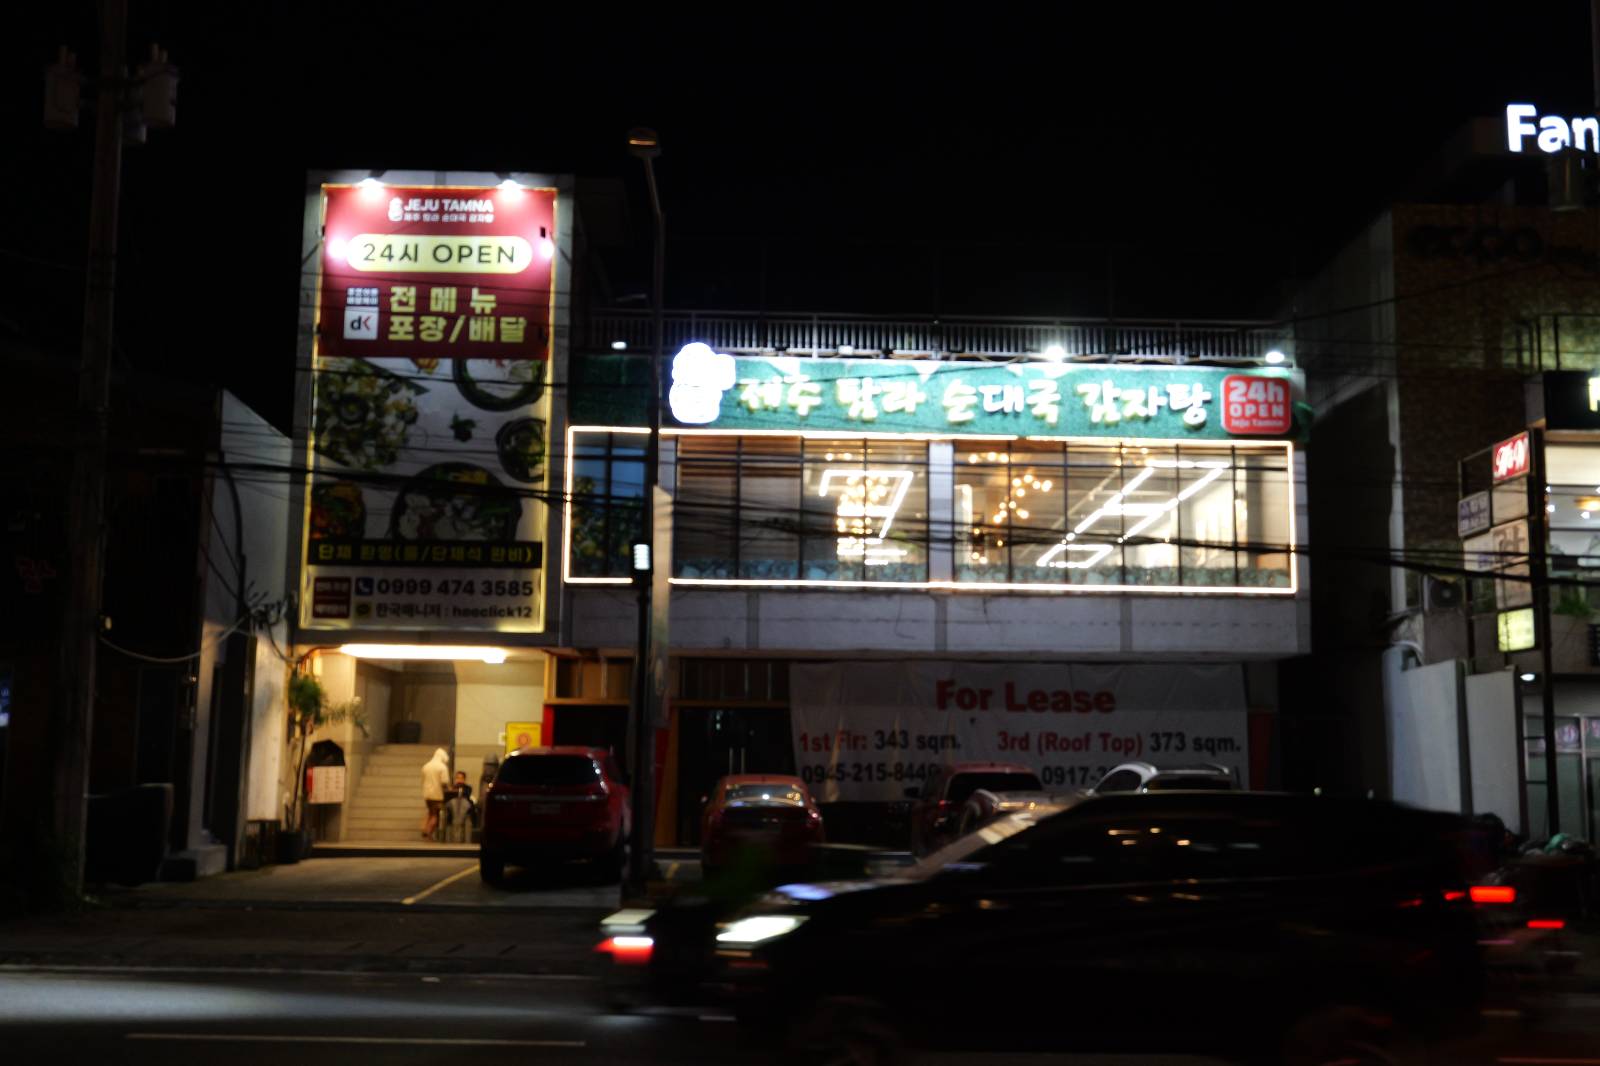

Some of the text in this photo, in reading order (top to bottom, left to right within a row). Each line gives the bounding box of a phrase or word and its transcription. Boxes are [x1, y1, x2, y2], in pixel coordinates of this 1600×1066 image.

[404, 199, 494, 213] JEJU TAMNA
[363, 243, 515, 264] 24시 OPEN
[388, 315, 527, 343] 포장/배달
[739, 375, 822, 416] 제주
[942, 378, 1061, 423] 순대국
[1077, 380, 1211, 425] 감자탕
[1229, 380, 1284, 402] 24h
[1230, 403, 1284, 417] OPEN
[376, 578, 533, 597] 0999 474 3585
[937, 680, 1116, 713] For Lease
[799, 732, 830, 752] 1st
[873, 730, 909, 750] 343
[916, 734, 961, 754] sqm.
[998, 731, 1241, 757] 3rd (Roof Top) 373 sqm.
